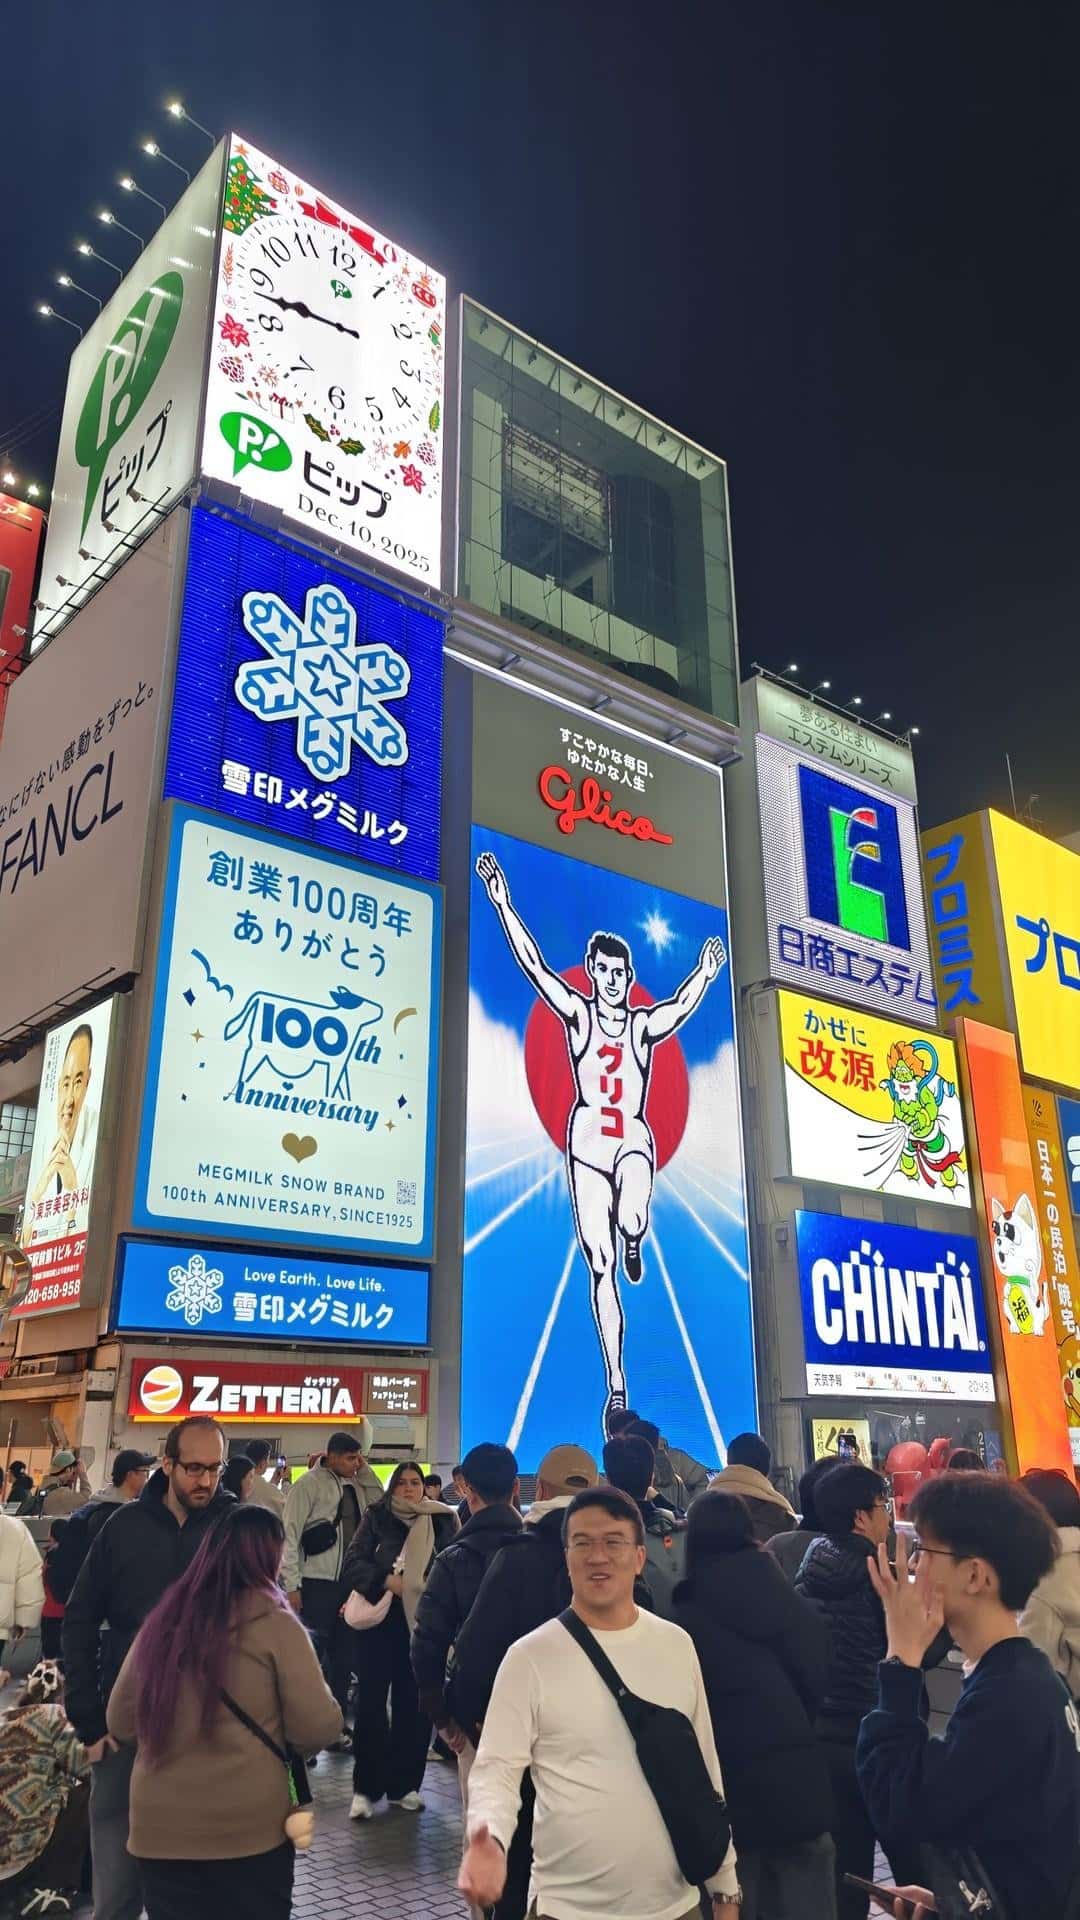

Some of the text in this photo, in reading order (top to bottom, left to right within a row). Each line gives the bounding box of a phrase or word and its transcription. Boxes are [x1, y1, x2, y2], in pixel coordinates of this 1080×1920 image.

[261, 236, 292, 268] 10
[294, 231, 320, 259] 11
[328, 246, 357, 278] 12
[249, 267, 275, 293] 9
[372, 285, 386, 299] 1
[258, 313, 284, 332] 8
[391, 323, 413, 340] 2
[290, 355, 316, 372] 7
[399, 359, 422, 383] 3
[327, 385, 346, 411] 6
[364, 396, 384, 422] 5
[391, 386, 412, 409] 4
[102, 399, 173, 522] ピップ
[303, 450, 392, 519] ピップ
[298, 493, 343, 530] Dec.
[381, 536, 430, 572] 2025
[559, 727, 654, 779] すこやかな毎日、
[567, 748, 646, 792] ゆたかな人生
[222, 759, 409, 845] 雪印メグミルク
[538, 765, 673, 845] Glico
[0, 750, 123, 894] FANCL
[207, 850, 413, 938] 創業100周年
[927, 833, 982, 1012] プロミス
[233, 909, 386, 977] ありがとう
[778, 924, 938, 1008] 日商エステム
[804, 1009, 867, 1047] かぜに
[798, 1036, 877, 1092] 改源
[223, 1081, 379, 1132] Anniversary
[597, 1040, 626, 1139] グリコ
[162, 1185, 207, 1204] 100th
[198, 1163, 385, 1201] MEGMILK SNOW BRAND
[244, 1266, 385, 1292] Love Earth. Love Life.
[233, 1291, 394, 1329] 雪印メグミルク
[189, 1376, 354, 1414] ZETTERIA
